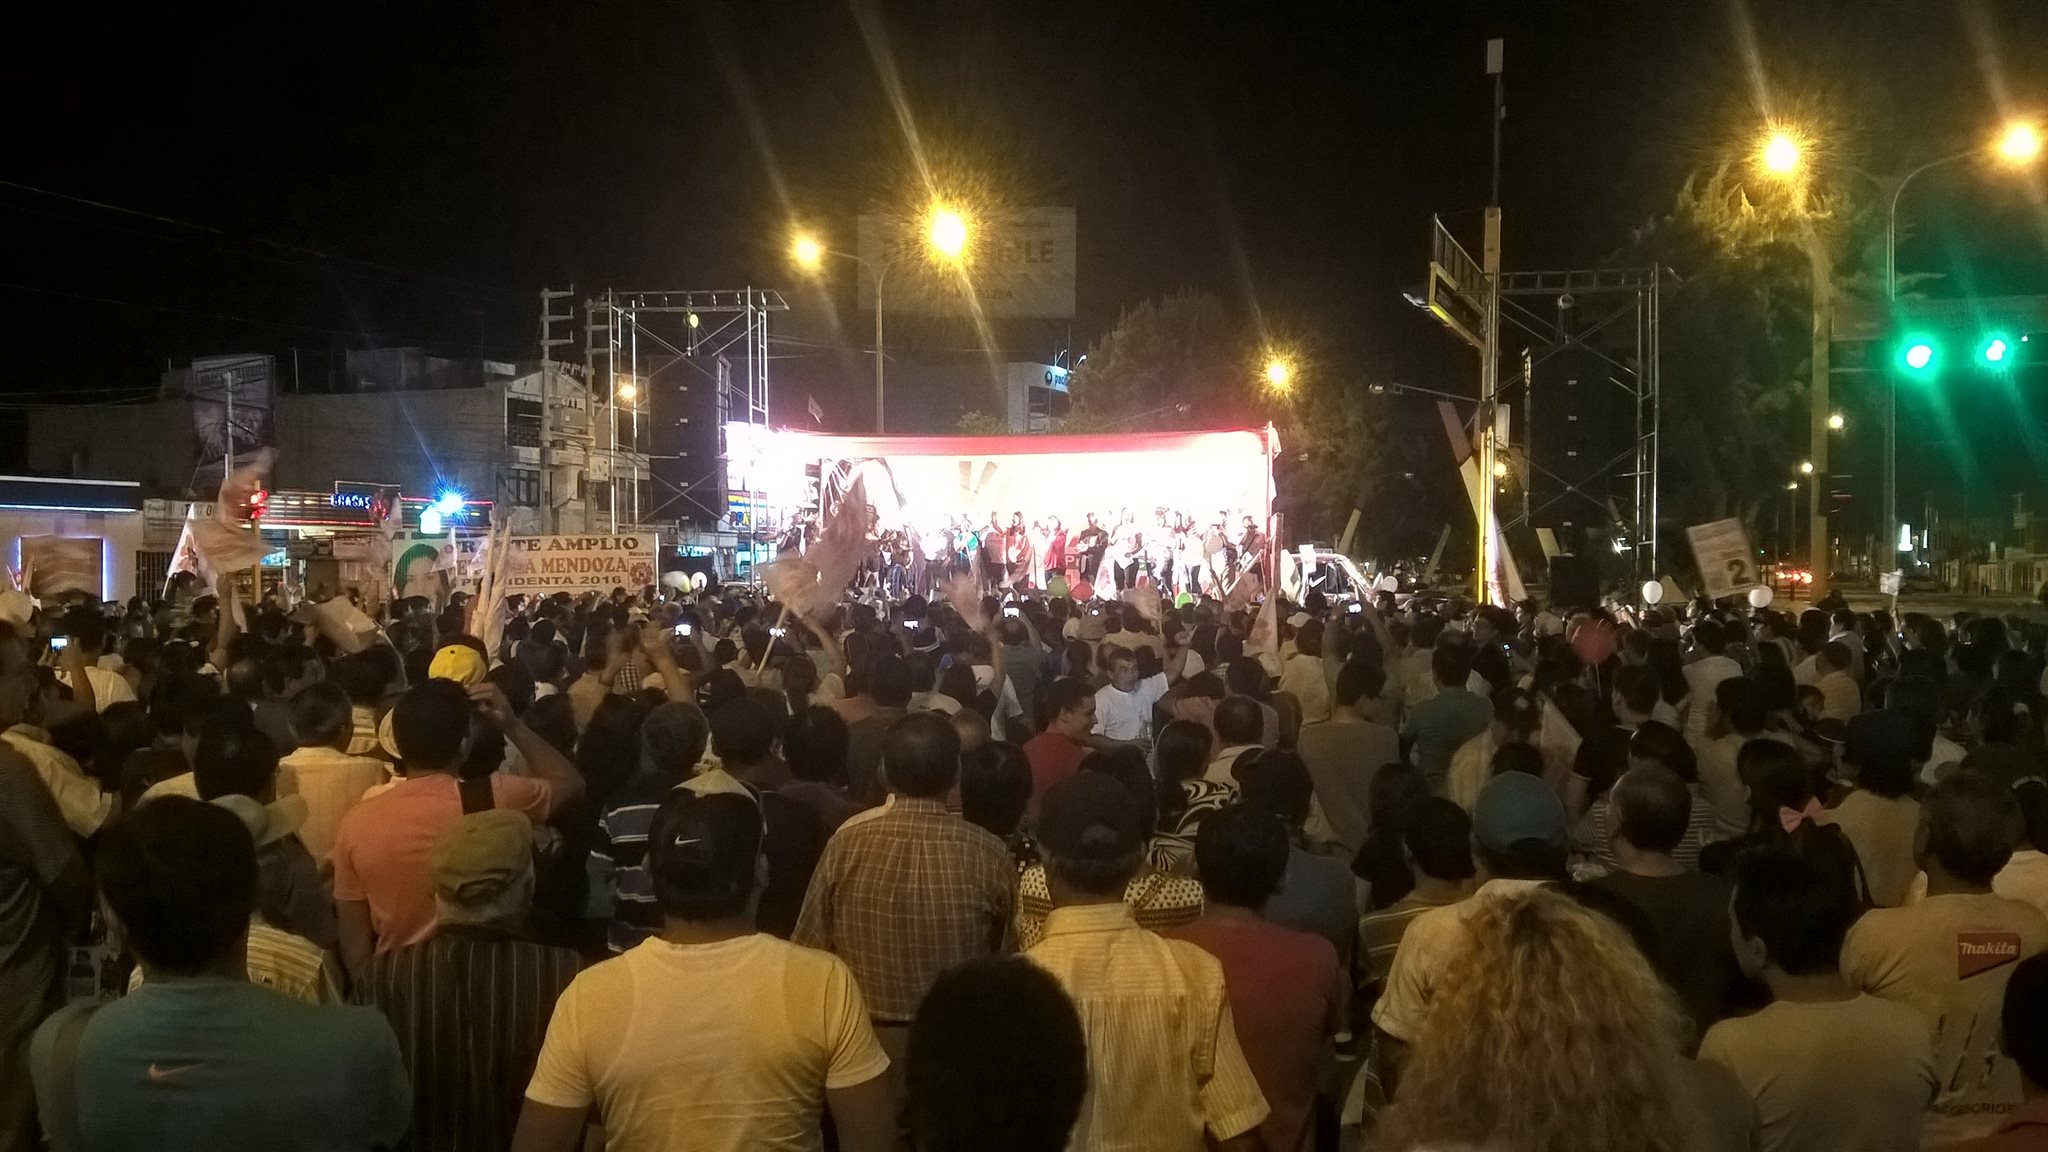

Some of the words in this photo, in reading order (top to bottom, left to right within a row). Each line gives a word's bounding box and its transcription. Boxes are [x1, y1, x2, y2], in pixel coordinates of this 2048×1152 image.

[546, 537, 639, 550] AMPLIO
[541, 556, 628, 573] MENDOZA
[1727, 558, 1752, 586] 2
[580, 575, 622, 585] 2016
